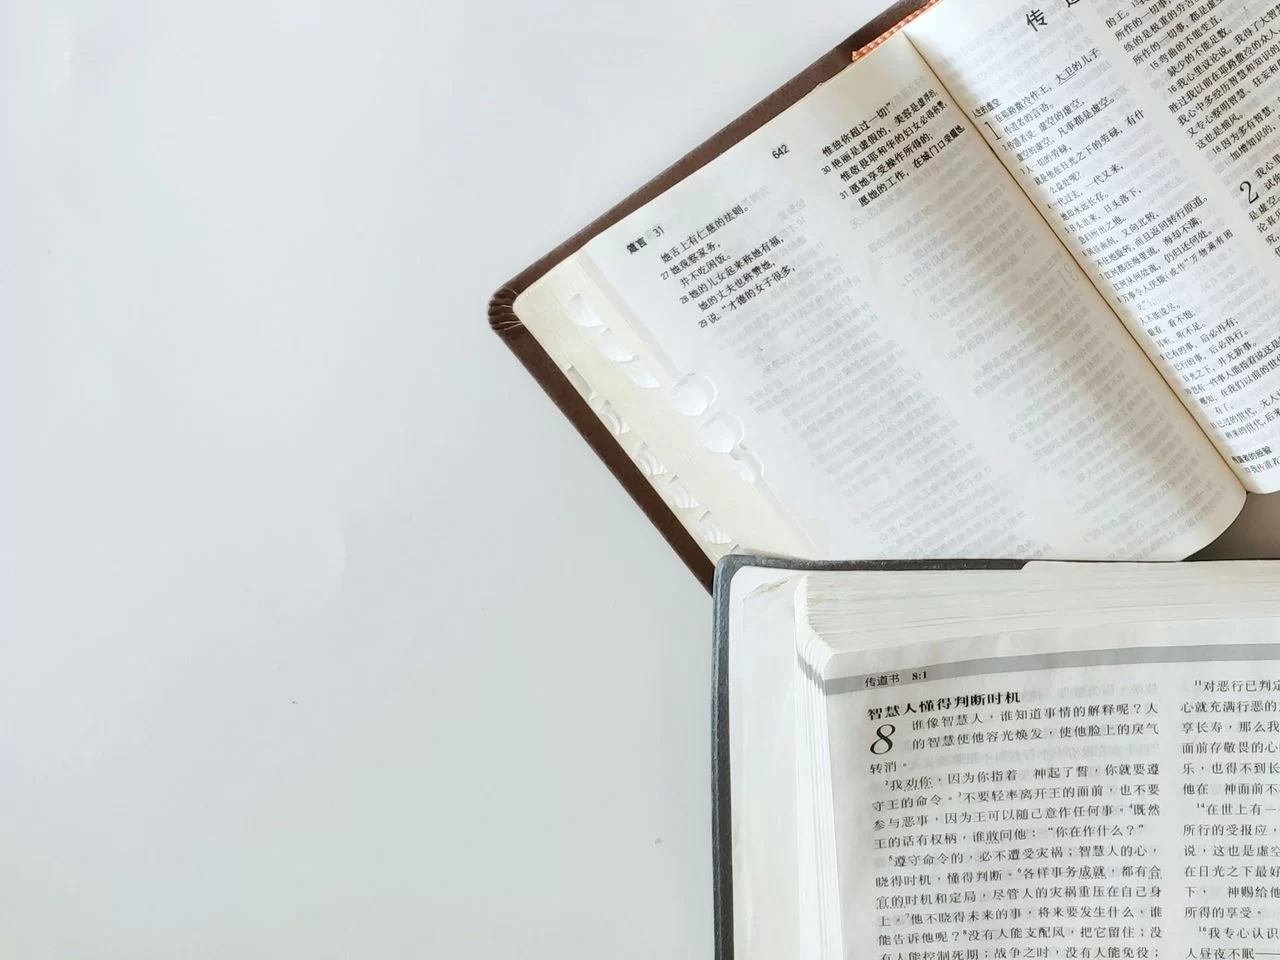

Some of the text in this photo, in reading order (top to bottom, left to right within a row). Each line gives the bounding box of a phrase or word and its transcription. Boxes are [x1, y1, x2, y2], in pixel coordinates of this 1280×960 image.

[772, 144, 790, 160] 642
[1240, 180, 1260, 204] 2
[653, 226, 665, 237] 31
[865, 672, 928, 688] 传道书 8:1
[867, 691, 1020, 720] 智慧人懂得判断时机
[870, 723, 896, 755] 8
[1184, 906, 1262, 919] 所得的享受。
